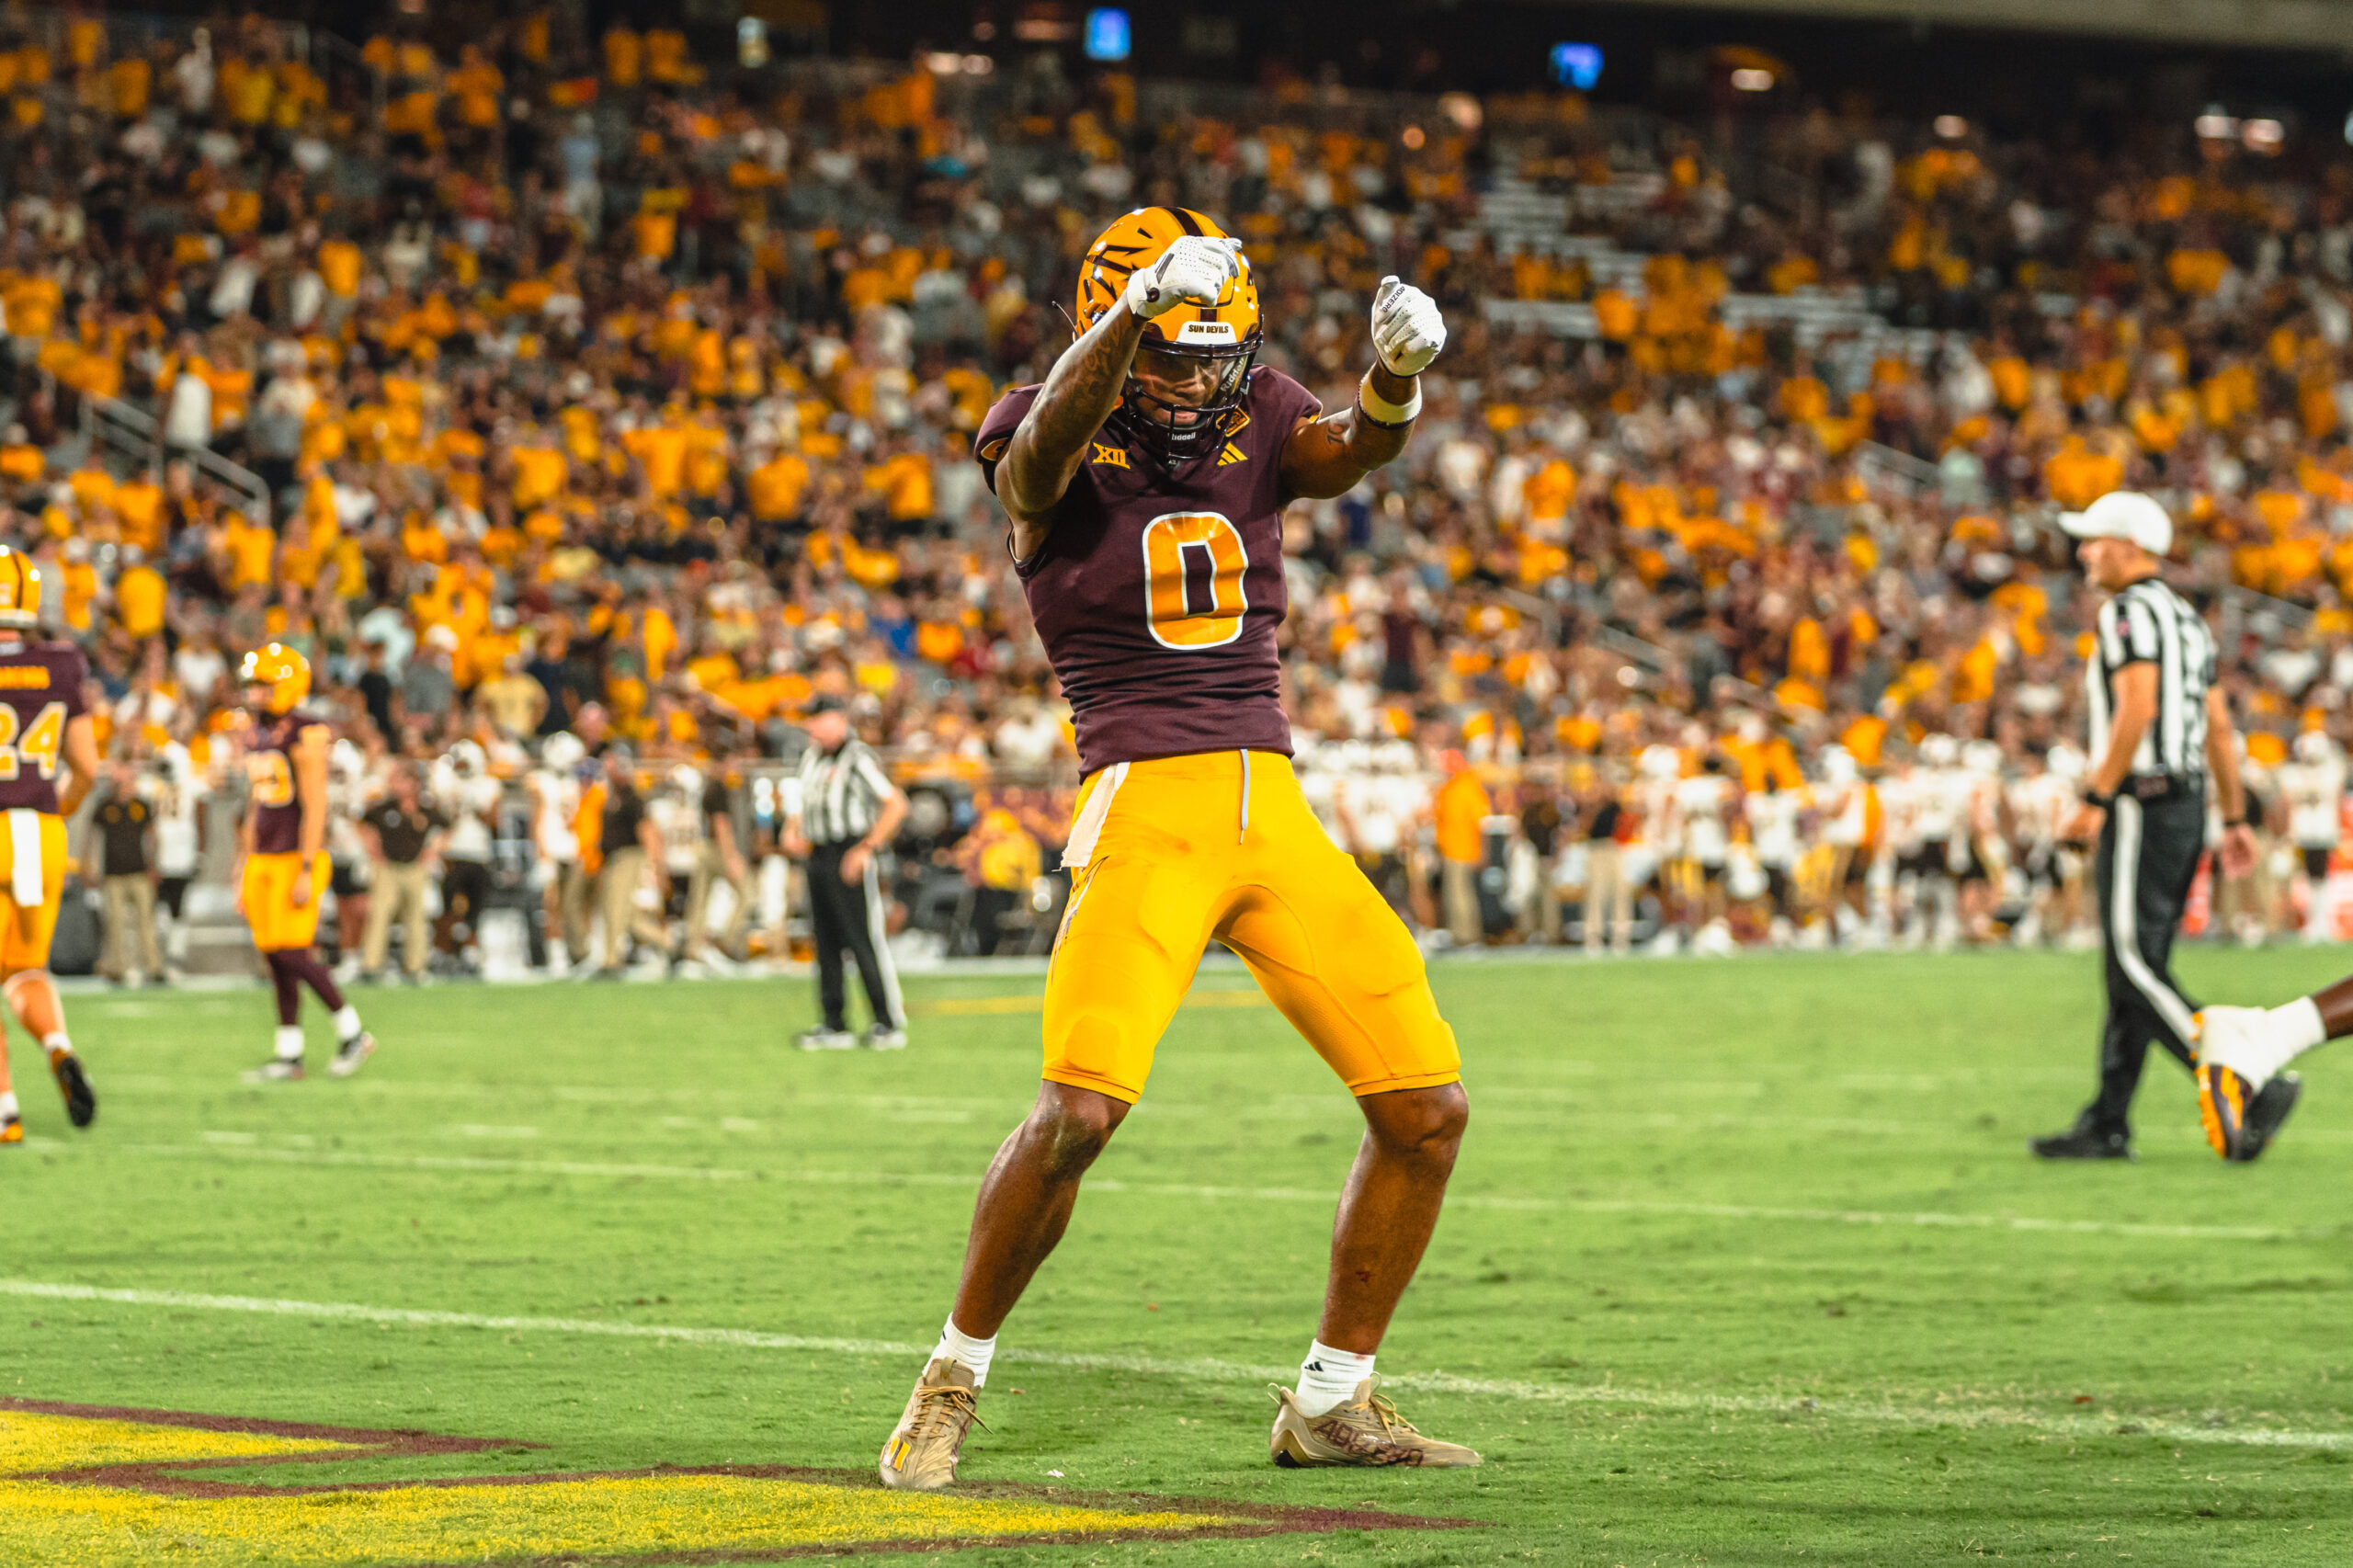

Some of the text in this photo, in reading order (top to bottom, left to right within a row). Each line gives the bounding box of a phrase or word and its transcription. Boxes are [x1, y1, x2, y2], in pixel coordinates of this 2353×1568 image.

[1381, 286, 1405, 313] ADIZERO
[1188, 324, 1229, 334] SUN DEVILS
[1092, 442, 1131, 470] XII
[1142, 511, 1249, 651] 0
[1312, 1419, 1425, 1467] ADIZO
